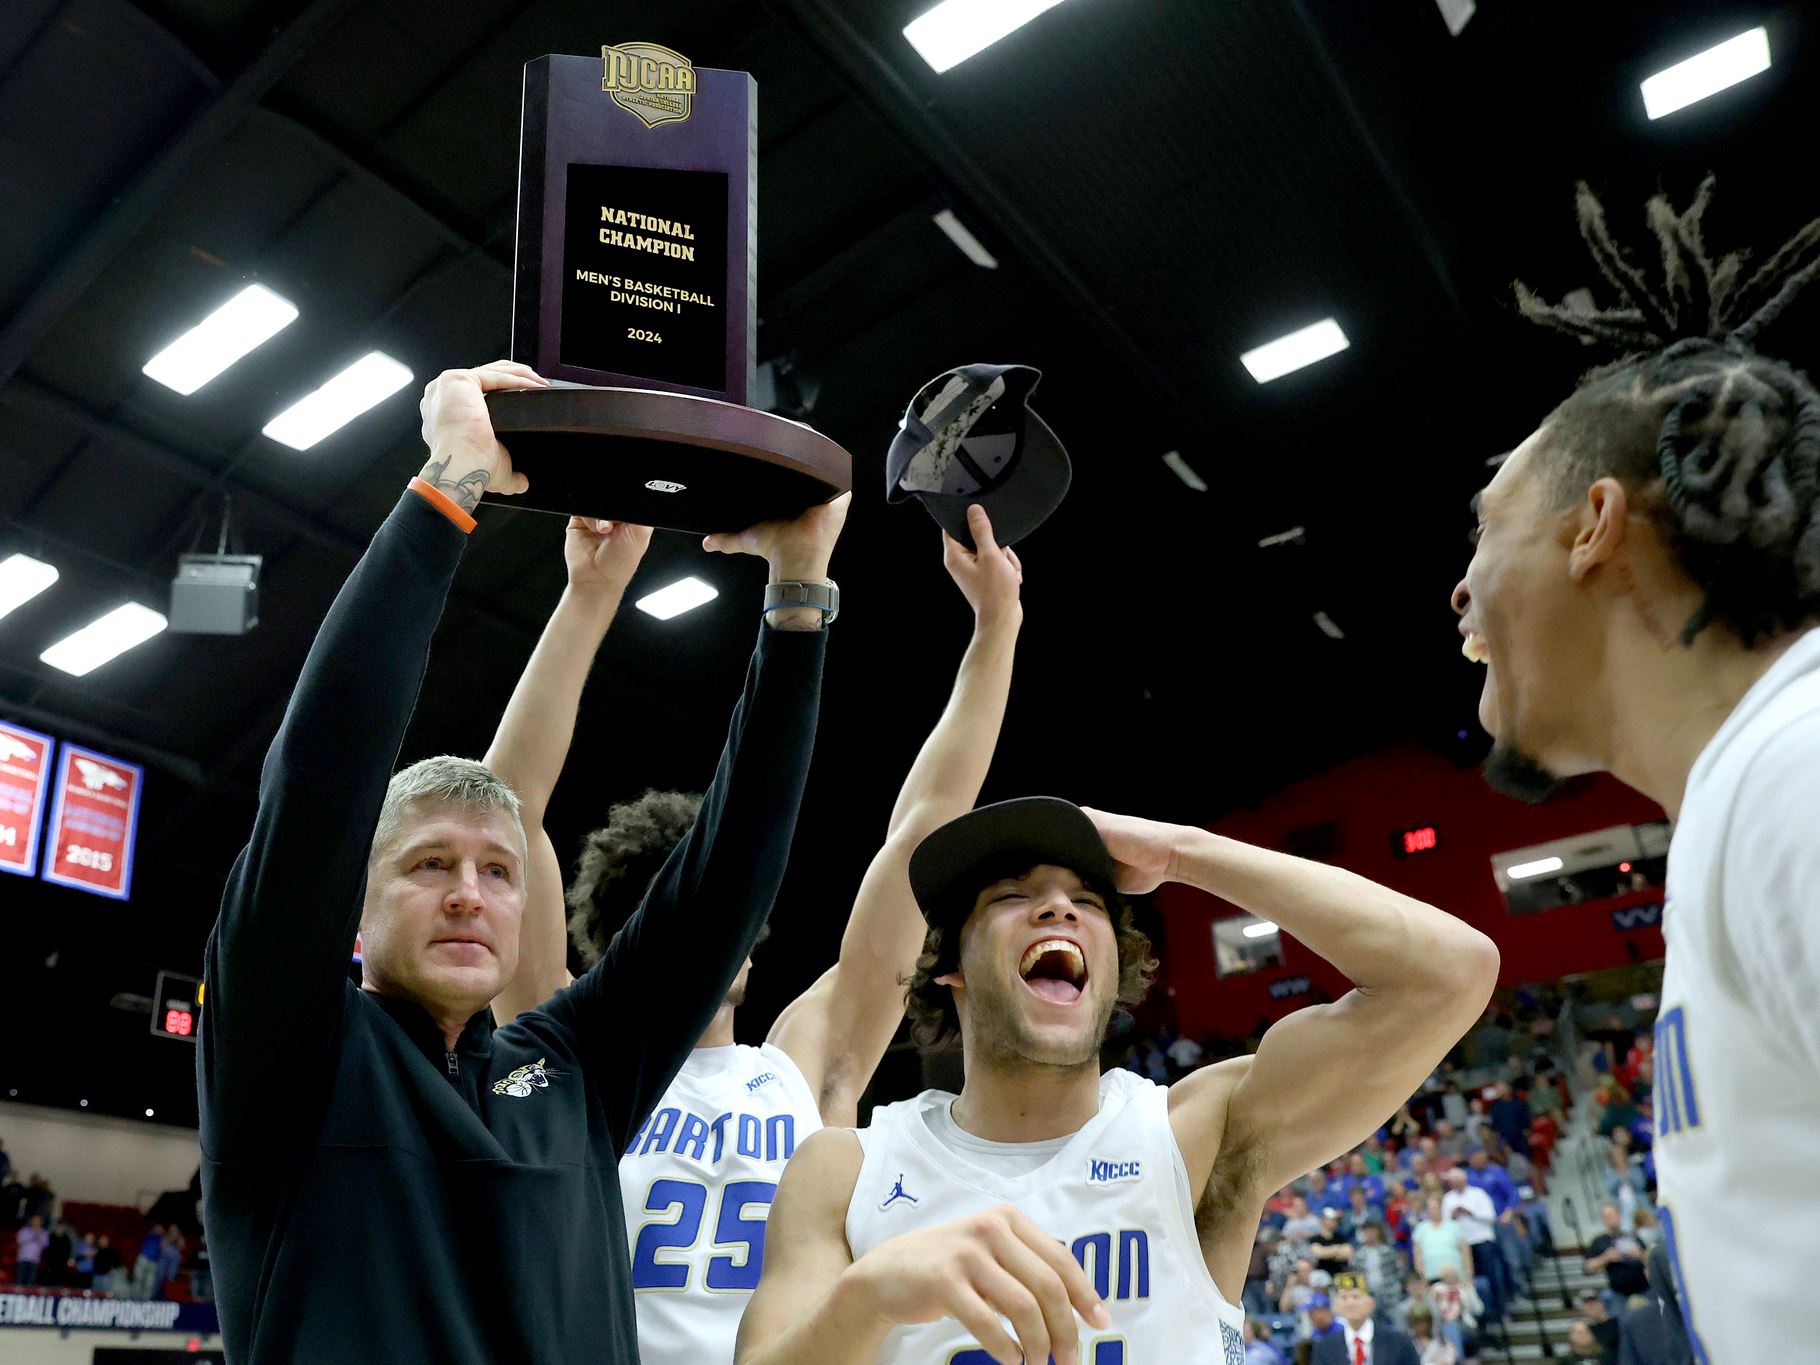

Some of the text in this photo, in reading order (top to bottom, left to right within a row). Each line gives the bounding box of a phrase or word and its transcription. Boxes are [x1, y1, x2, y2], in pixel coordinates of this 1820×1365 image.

[605, 47, 694, 92] NJCAA
[600, 206, 695, 240] NATIONAL
[599, 228, 695, 262] CHAMPION
[576, 269, 715, 307] MEN'S BASKETBALL
[610, 290, 681, 314] DIVISION I
[627, 327, 663, 344] 2024
[65, 844, 114, 872] 2015
[1089, 1158, 1141, 1182] KJCCC
[631, 1178, 779, 1292] 25
[57, 1296, 180, 1330] CHAMPIONSHIP
